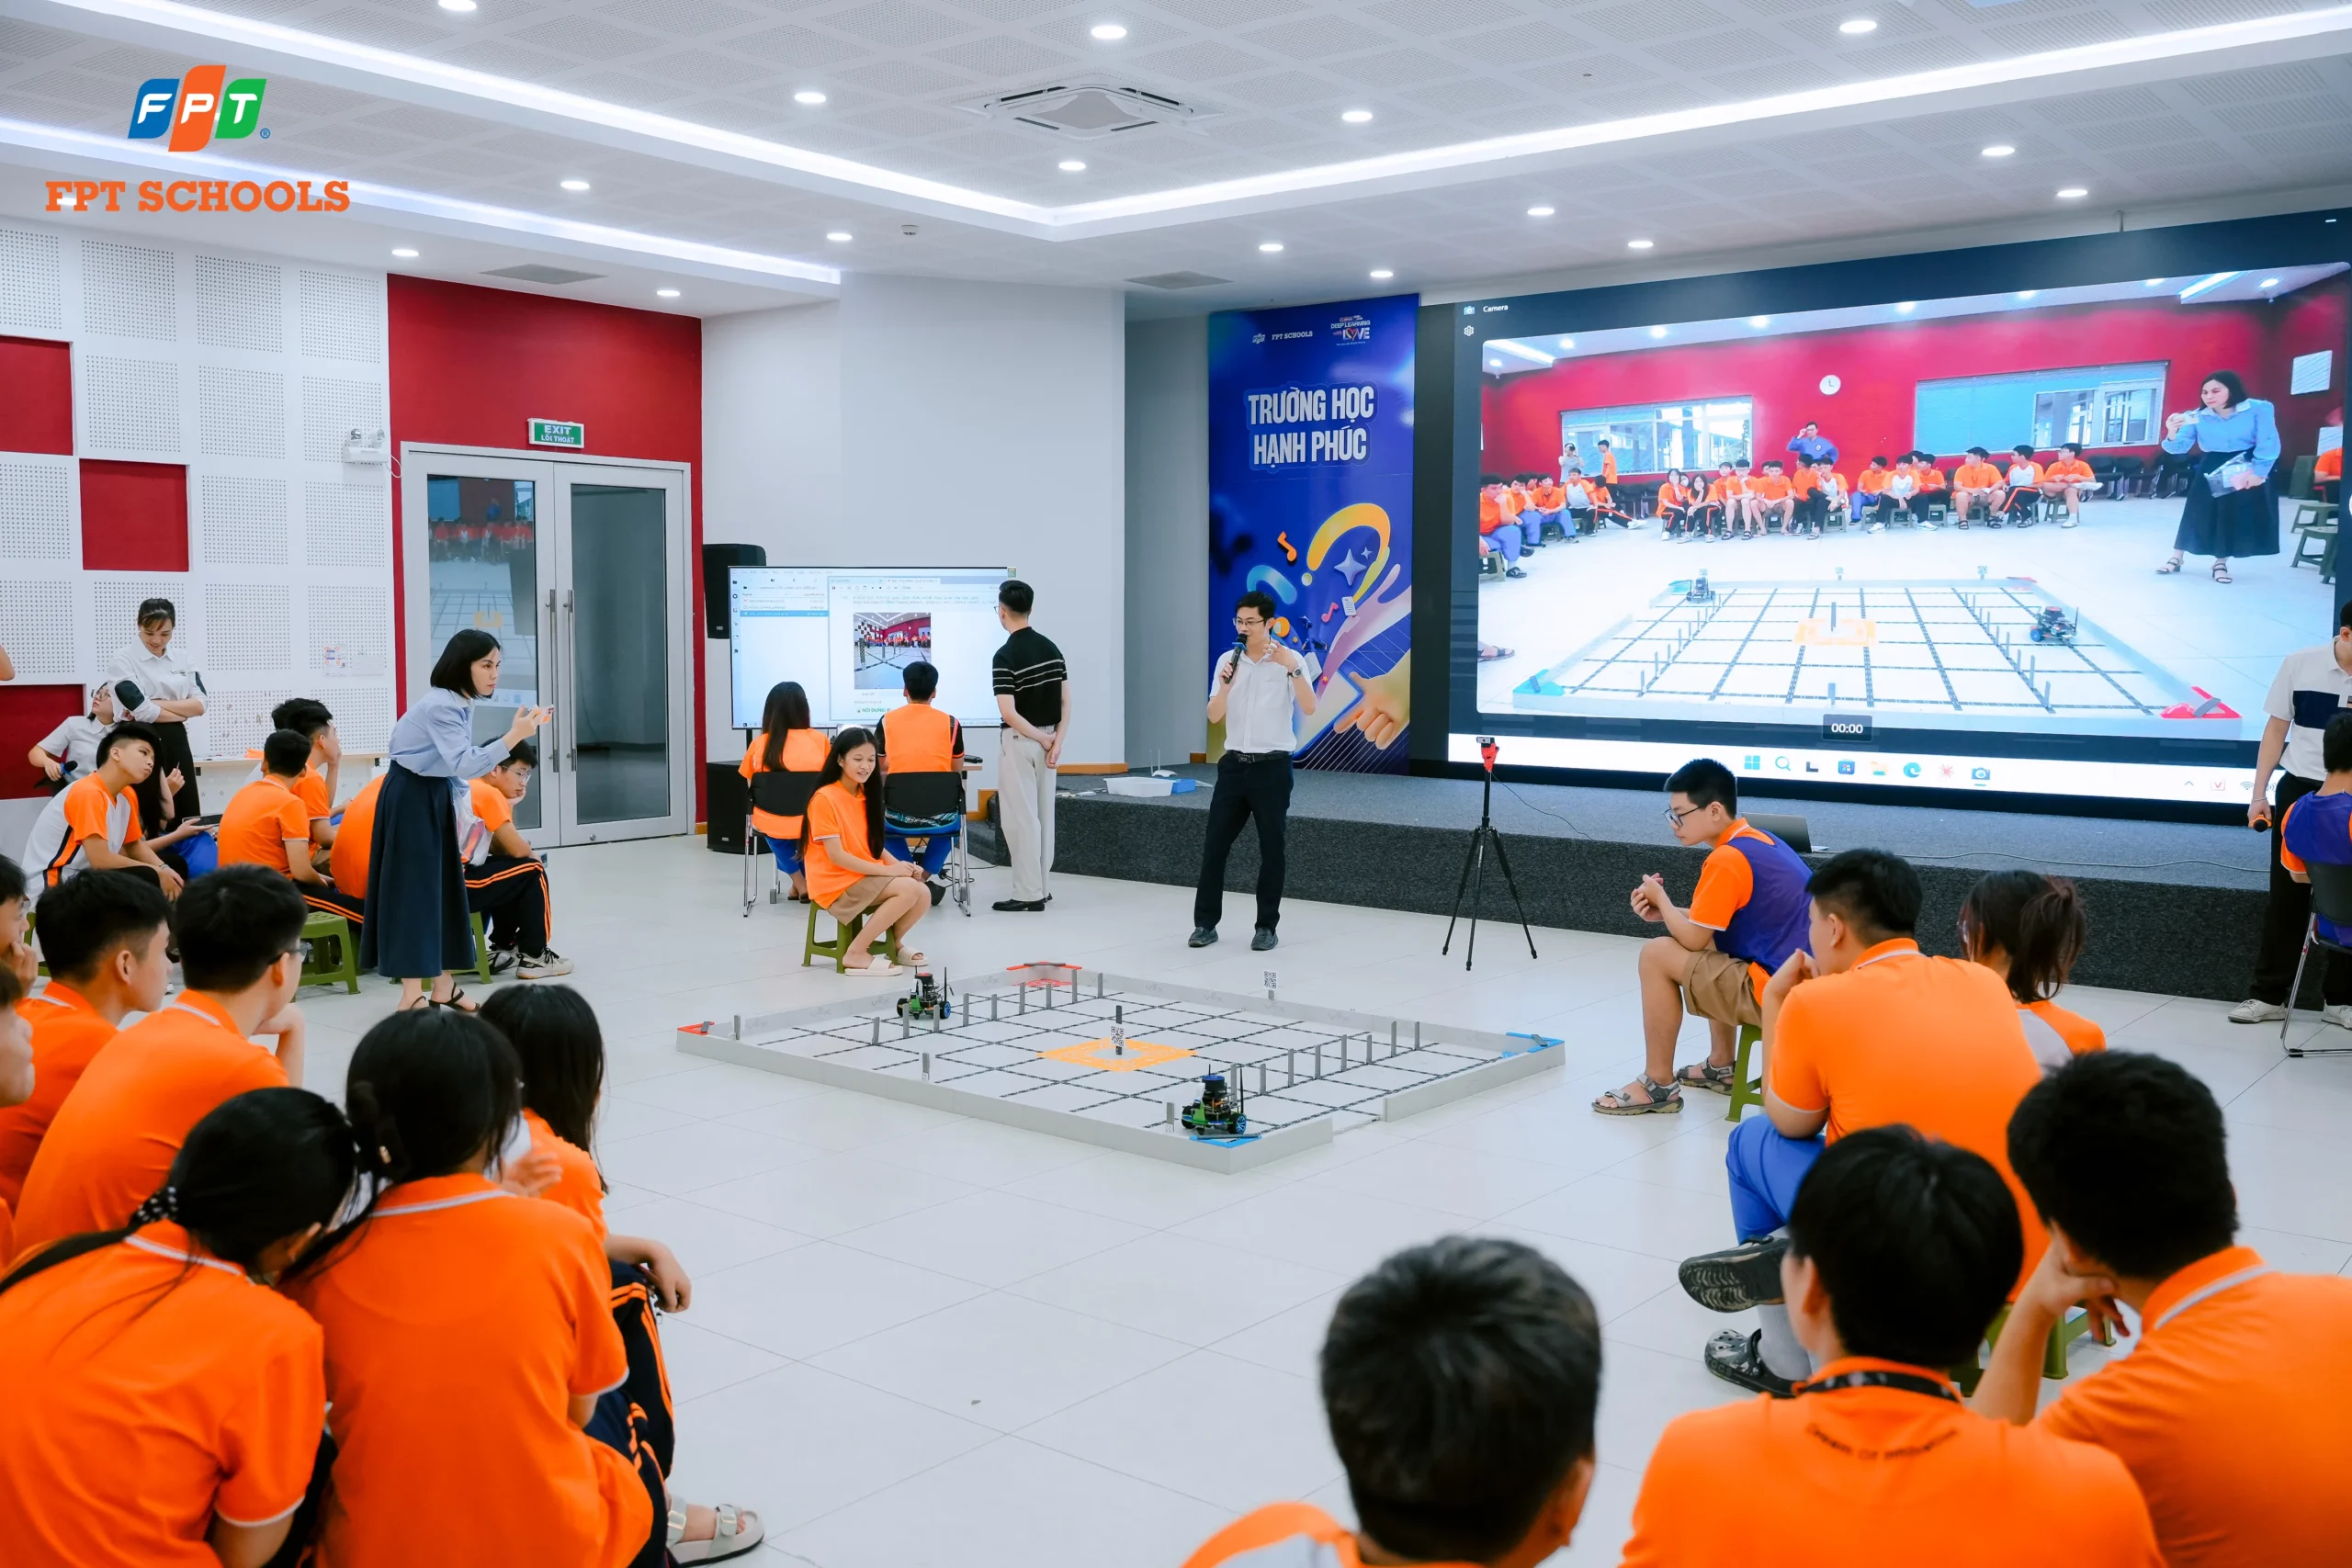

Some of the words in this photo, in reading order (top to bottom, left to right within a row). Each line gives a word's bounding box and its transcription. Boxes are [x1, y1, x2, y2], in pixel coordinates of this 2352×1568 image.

[1283, 331, 1314, 340] SCHOOLS
[1248, 387, 1327, 425] TRƯỜNG
[1331, 385, 1374, 423] HỌC
[544, 424, 572, 435] EXIT
[1253, 432, 1306, 468] HẠNH
[1311, 424, 1367, 462] PHÚC
[1831, 723, 1863, 734] 00:00
